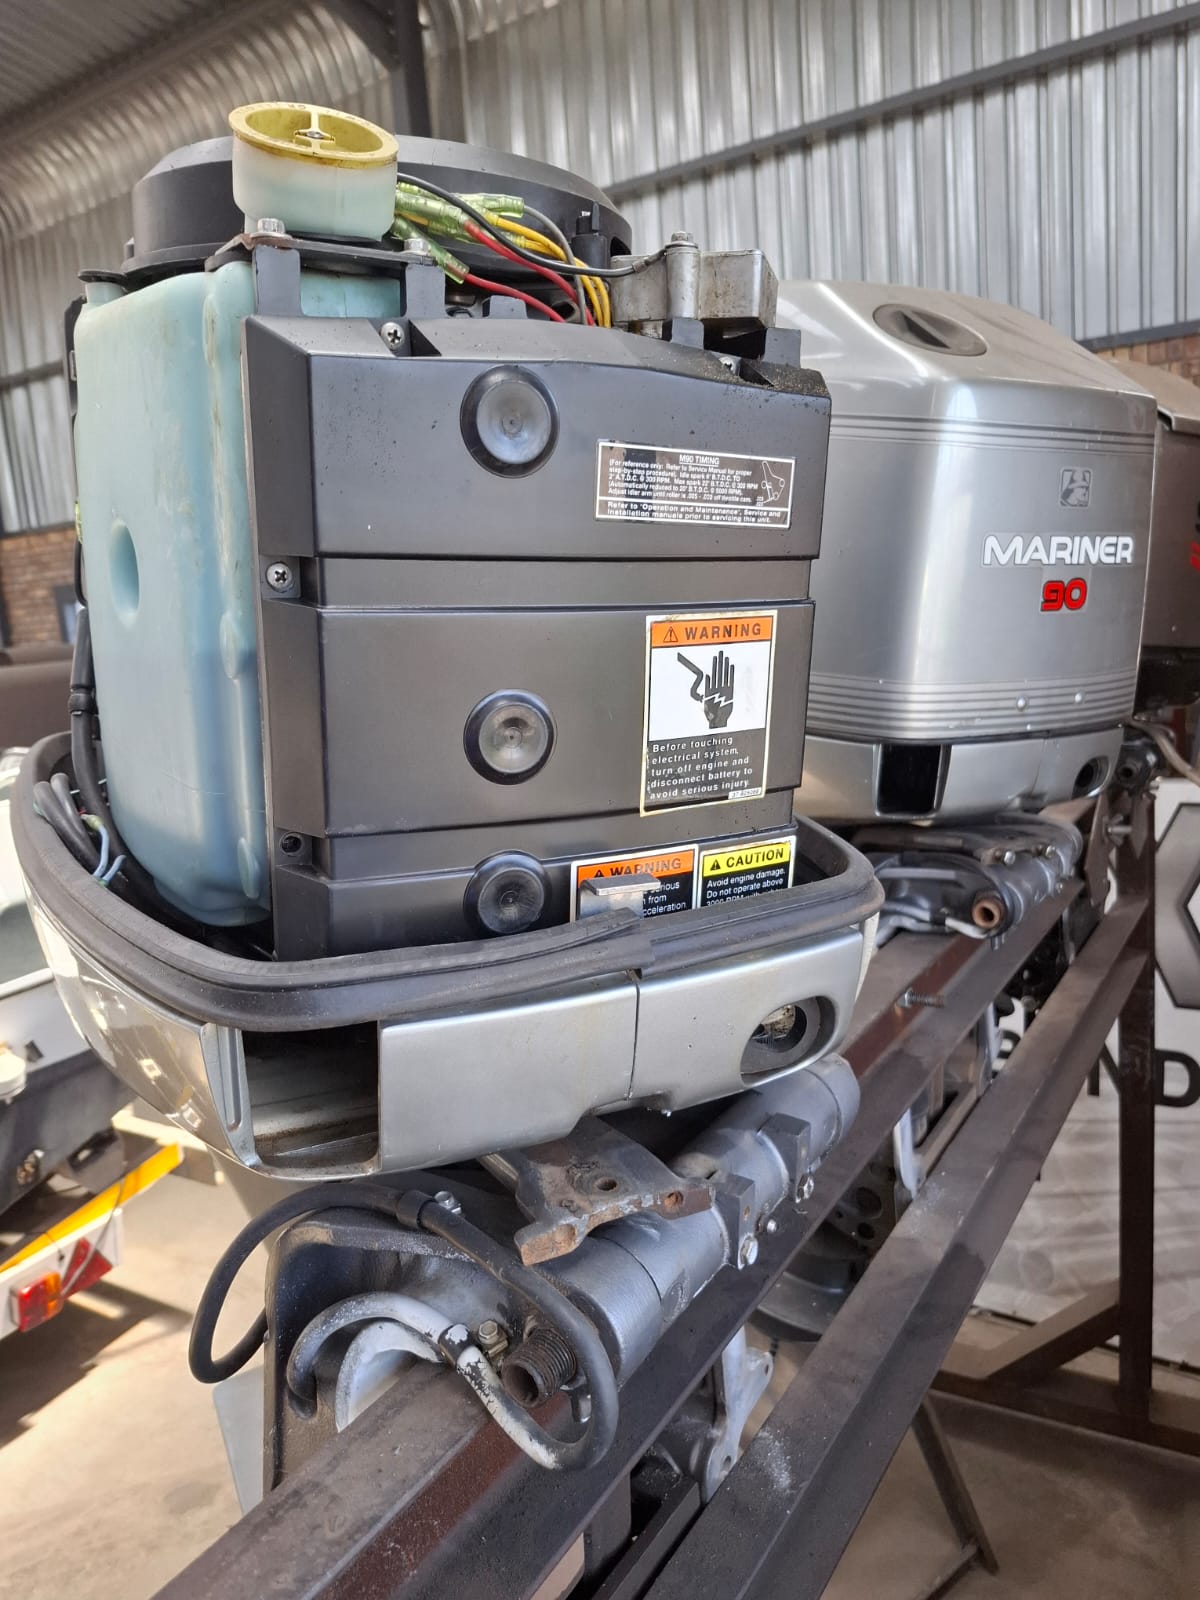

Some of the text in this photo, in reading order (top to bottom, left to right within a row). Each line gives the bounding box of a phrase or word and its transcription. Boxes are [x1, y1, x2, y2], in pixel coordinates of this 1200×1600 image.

[623, 460, 649, 468] reference
[708, 466, 726, 474] Manual
[696, 456, 719, 465] TIMING
[609, 466, 645, 475] step-by-step
[608, 488, 627, 496] Adjust
[652, 511, 683, 519] manuals
[983, 535, 1134, 566] MARINER
[1041, 578, 1088, 612] 90
[686, 623, 761, 640] WARNING
[653, 737, 733, 753] Before touching
[652, 752, 700, 764] electrical
[652, 756, 749, 776] turn off engine and
[650, 774, 705, 788] disconnect
[708, 770, 740, 780] battery
[650, 790, 678, 800] avoid
[682, 784, 718, 795] serious
[726, 848, 784, 868] CAUTION
[610, 858, 681, 875] WARNING
[706, 878, 783, 899] Do not operate above
[707, 877, 728, 888] Avoid
[730, 874, 754, 884] engine
[648, 894, 667, 904] from
